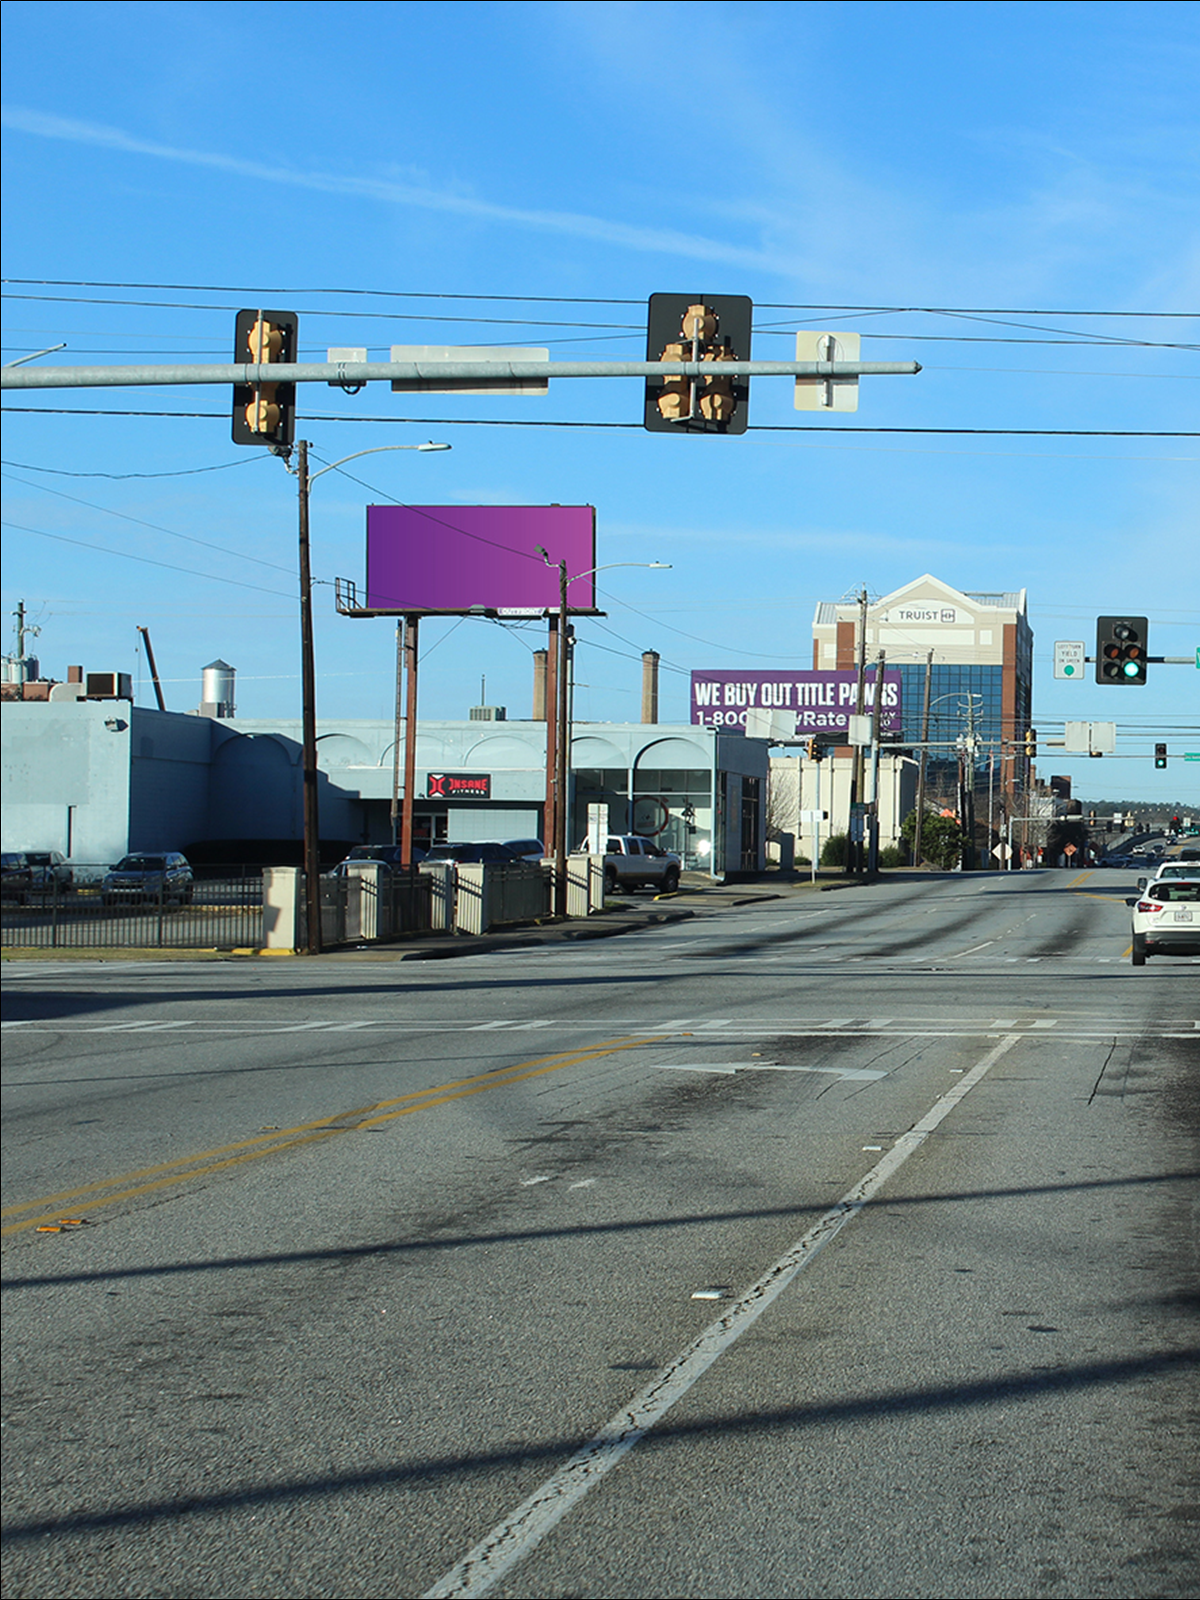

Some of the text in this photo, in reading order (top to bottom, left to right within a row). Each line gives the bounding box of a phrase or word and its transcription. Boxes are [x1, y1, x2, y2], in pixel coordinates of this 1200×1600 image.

[899, 611, 938, 620] TRUIST
[695, 683, 720, 706] WE
[724, 683, 757, 706] BUY
[761, 683, 793, 706] OUT
[796, 683, 835, 706] TITLE
[448, 778, 487, 790] INSANE
